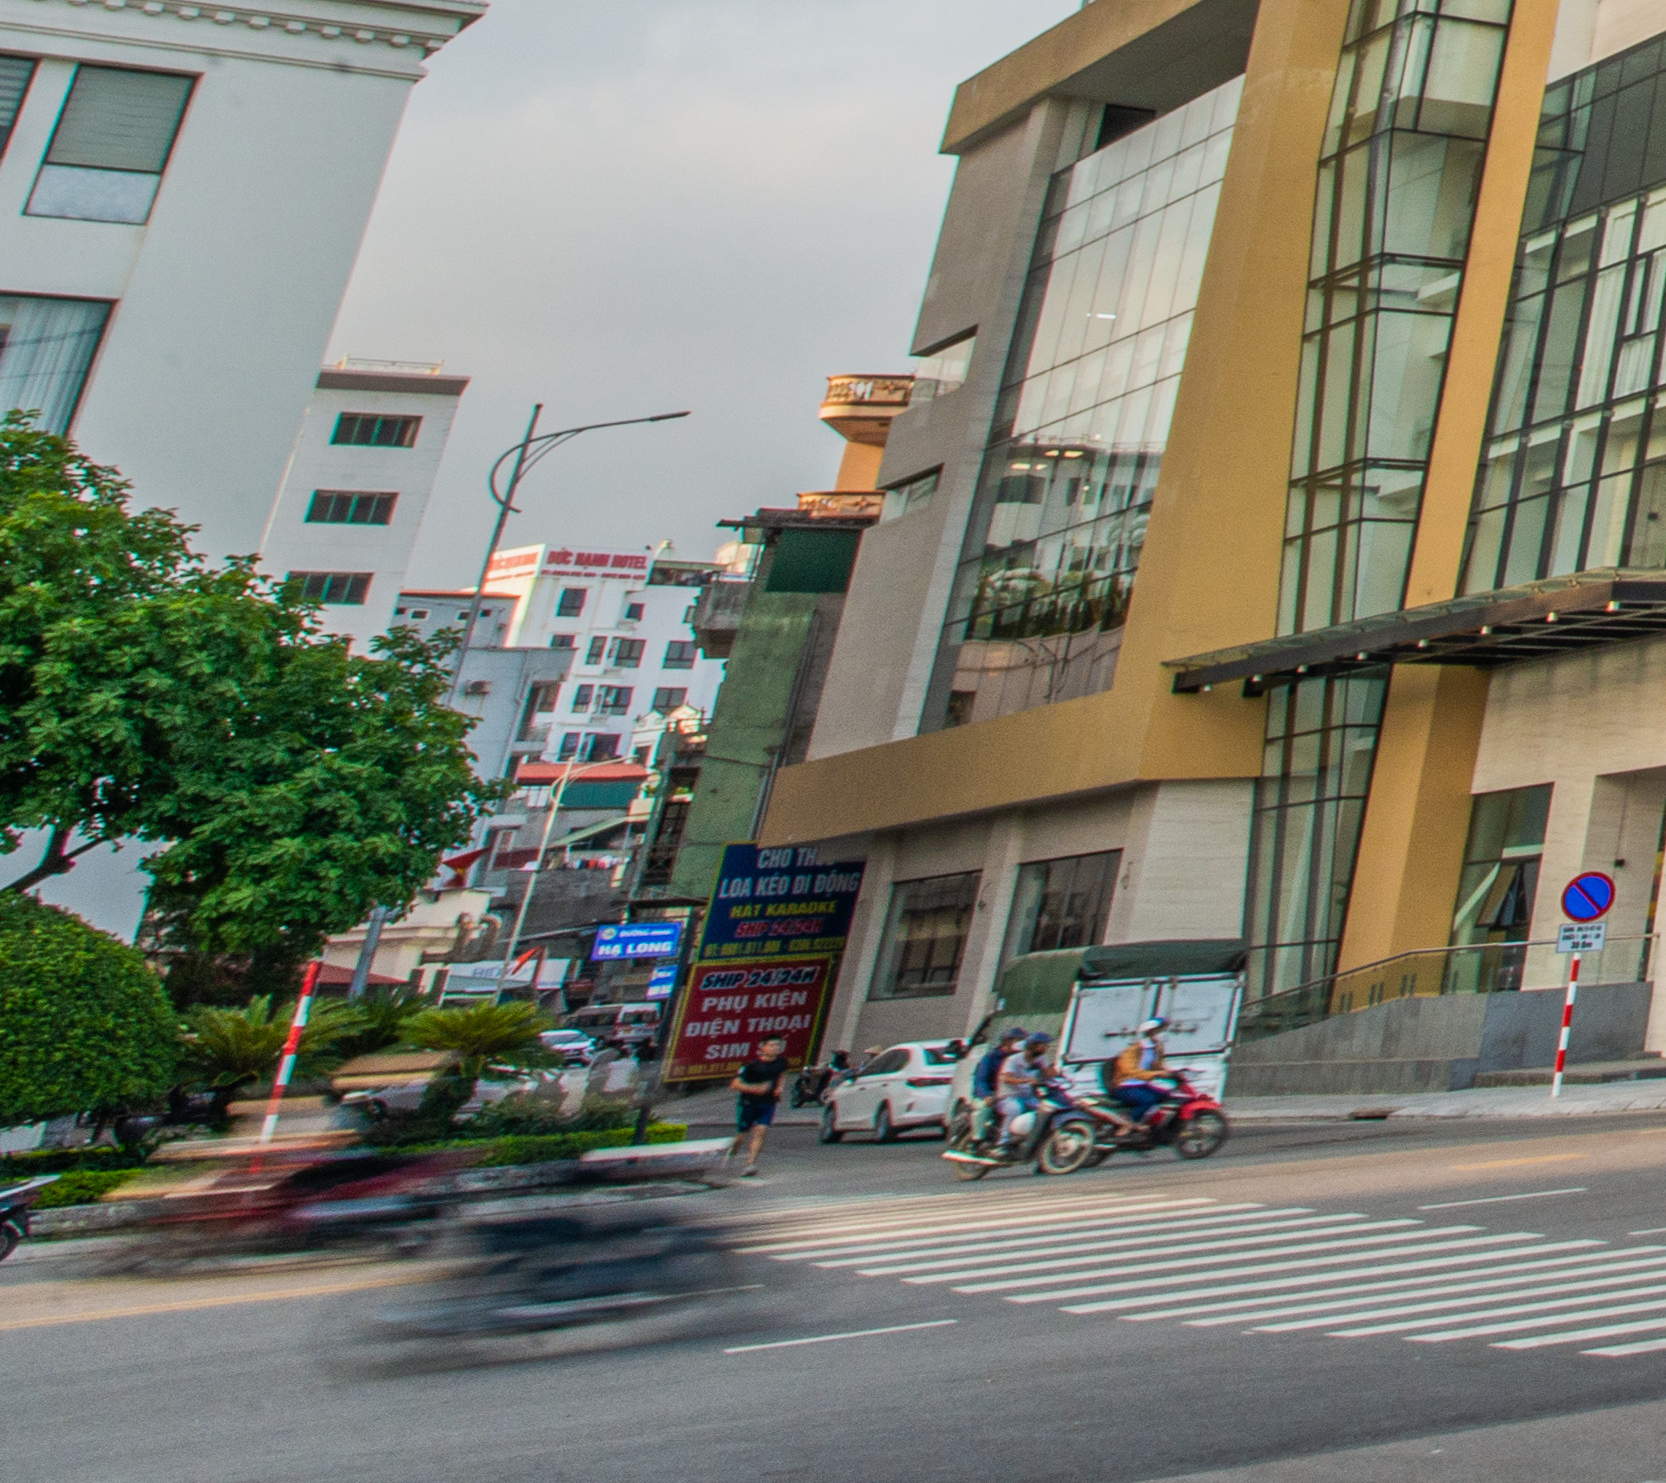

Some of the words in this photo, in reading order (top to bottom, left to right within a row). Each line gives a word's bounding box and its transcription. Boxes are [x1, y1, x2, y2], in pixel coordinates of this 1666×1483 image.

[611, 553, 648, 570] HOTEL
[757, 848, 794, 869] CHO
[718, 877, 752, 899] LOA
[755, 872, 791, 897] KÉO
[791, 874, 812, 895] DI
[765, 899, 838, 916] KARAOKE
[734, 920, 771, 939] SHIP
[625, 941, 674, 954] LONG
[701, 970, 748, 990] SHIP
[745, 966, 820, 987] 24/24H
[701, 995, 749, 1014] PHỤ
[753, 989, 808, 1010] KIỆN
[685, 1017, 741, 1039] ĐIỆN
[748, 1013, 812, 1033] THOẠI
[704, 1041, 751, 1060] SIM
